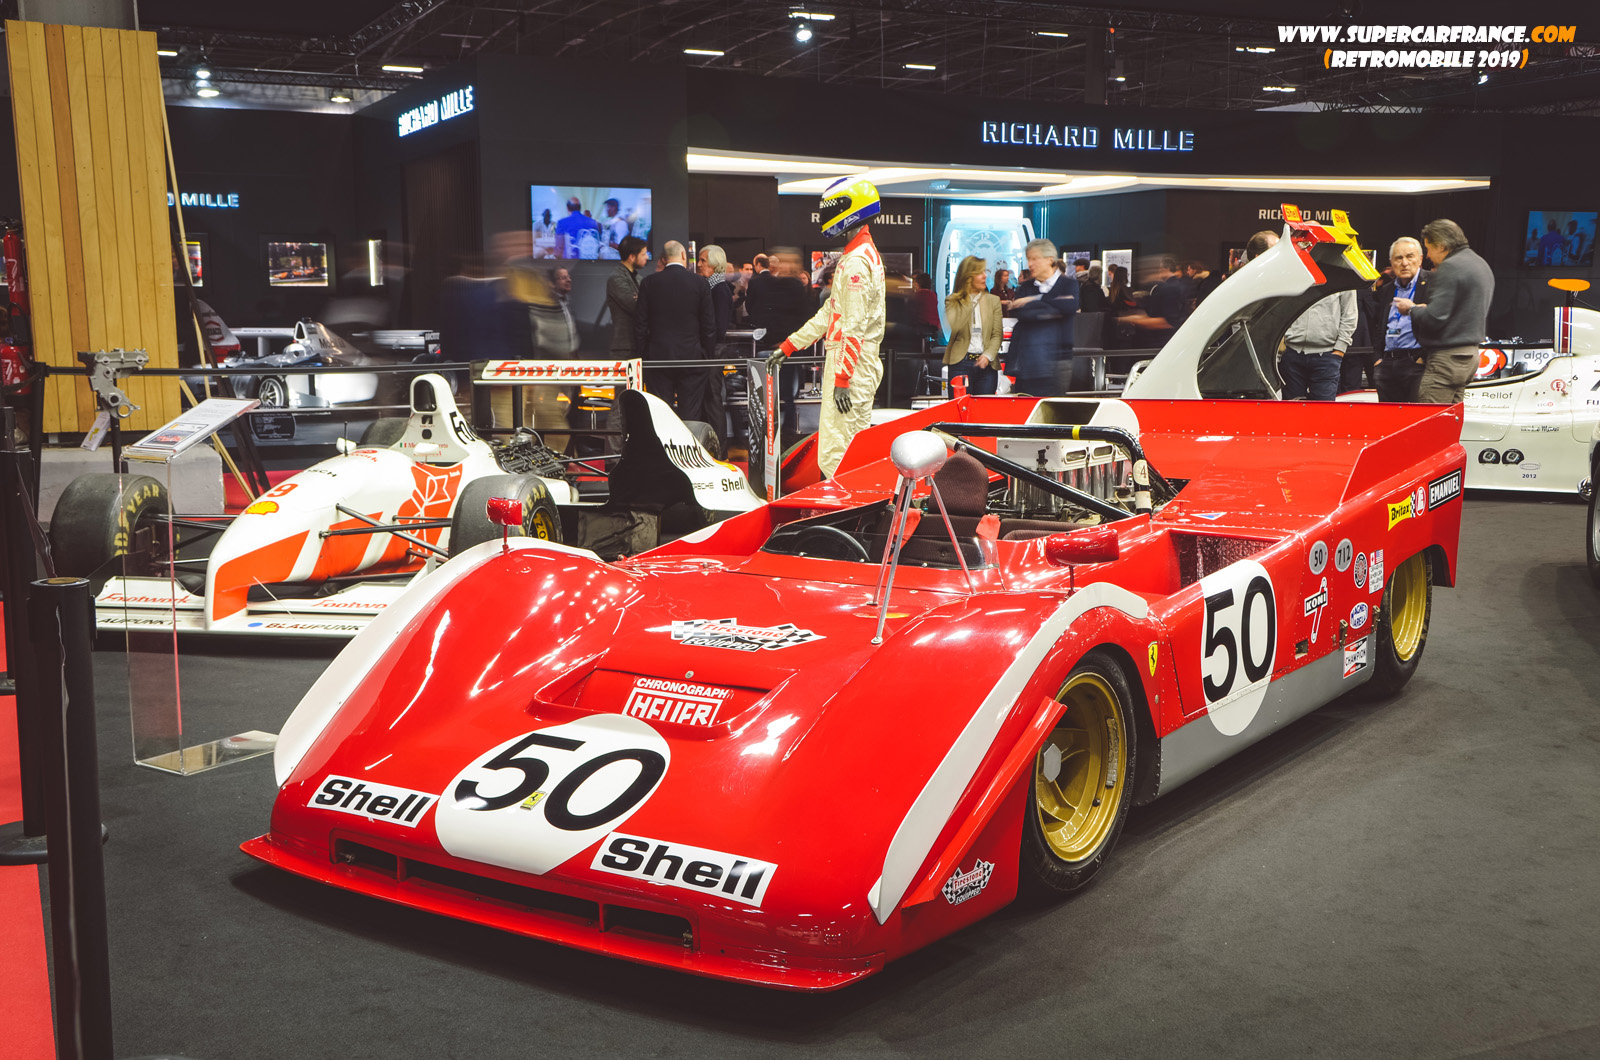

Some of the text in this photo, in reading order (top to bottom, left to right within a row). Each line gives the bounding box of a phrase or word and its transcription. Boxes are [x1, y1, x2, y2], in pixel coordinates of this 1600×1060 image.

[983, 121, 1195, 151] RICHARD MILLE
[180, 192, 239, 208] MILLE
[721, 477, 745, 492] Shell
[1430, 475, 1460, 504] EMANUEL
[1391, 504, 1410, 521] Britax
[1314, 548, 1323, 568] 50
[1337, 544, 1351, 566] 712
[312, 600, 388, 609] Footwo
[1306, 592, 1326, 613] KONI
[687, 636, 761, 650] EQUIPPED
[1203, 576, 1276, 704] 50
[636, 678, 729, 699] CHRONOGRAPH
[630, 695, 713, 726] HEUER
[455, 733, 666, 831] 50
[315, 779, 431, 823] Shell
[601, 837, 767, 900] Shell
